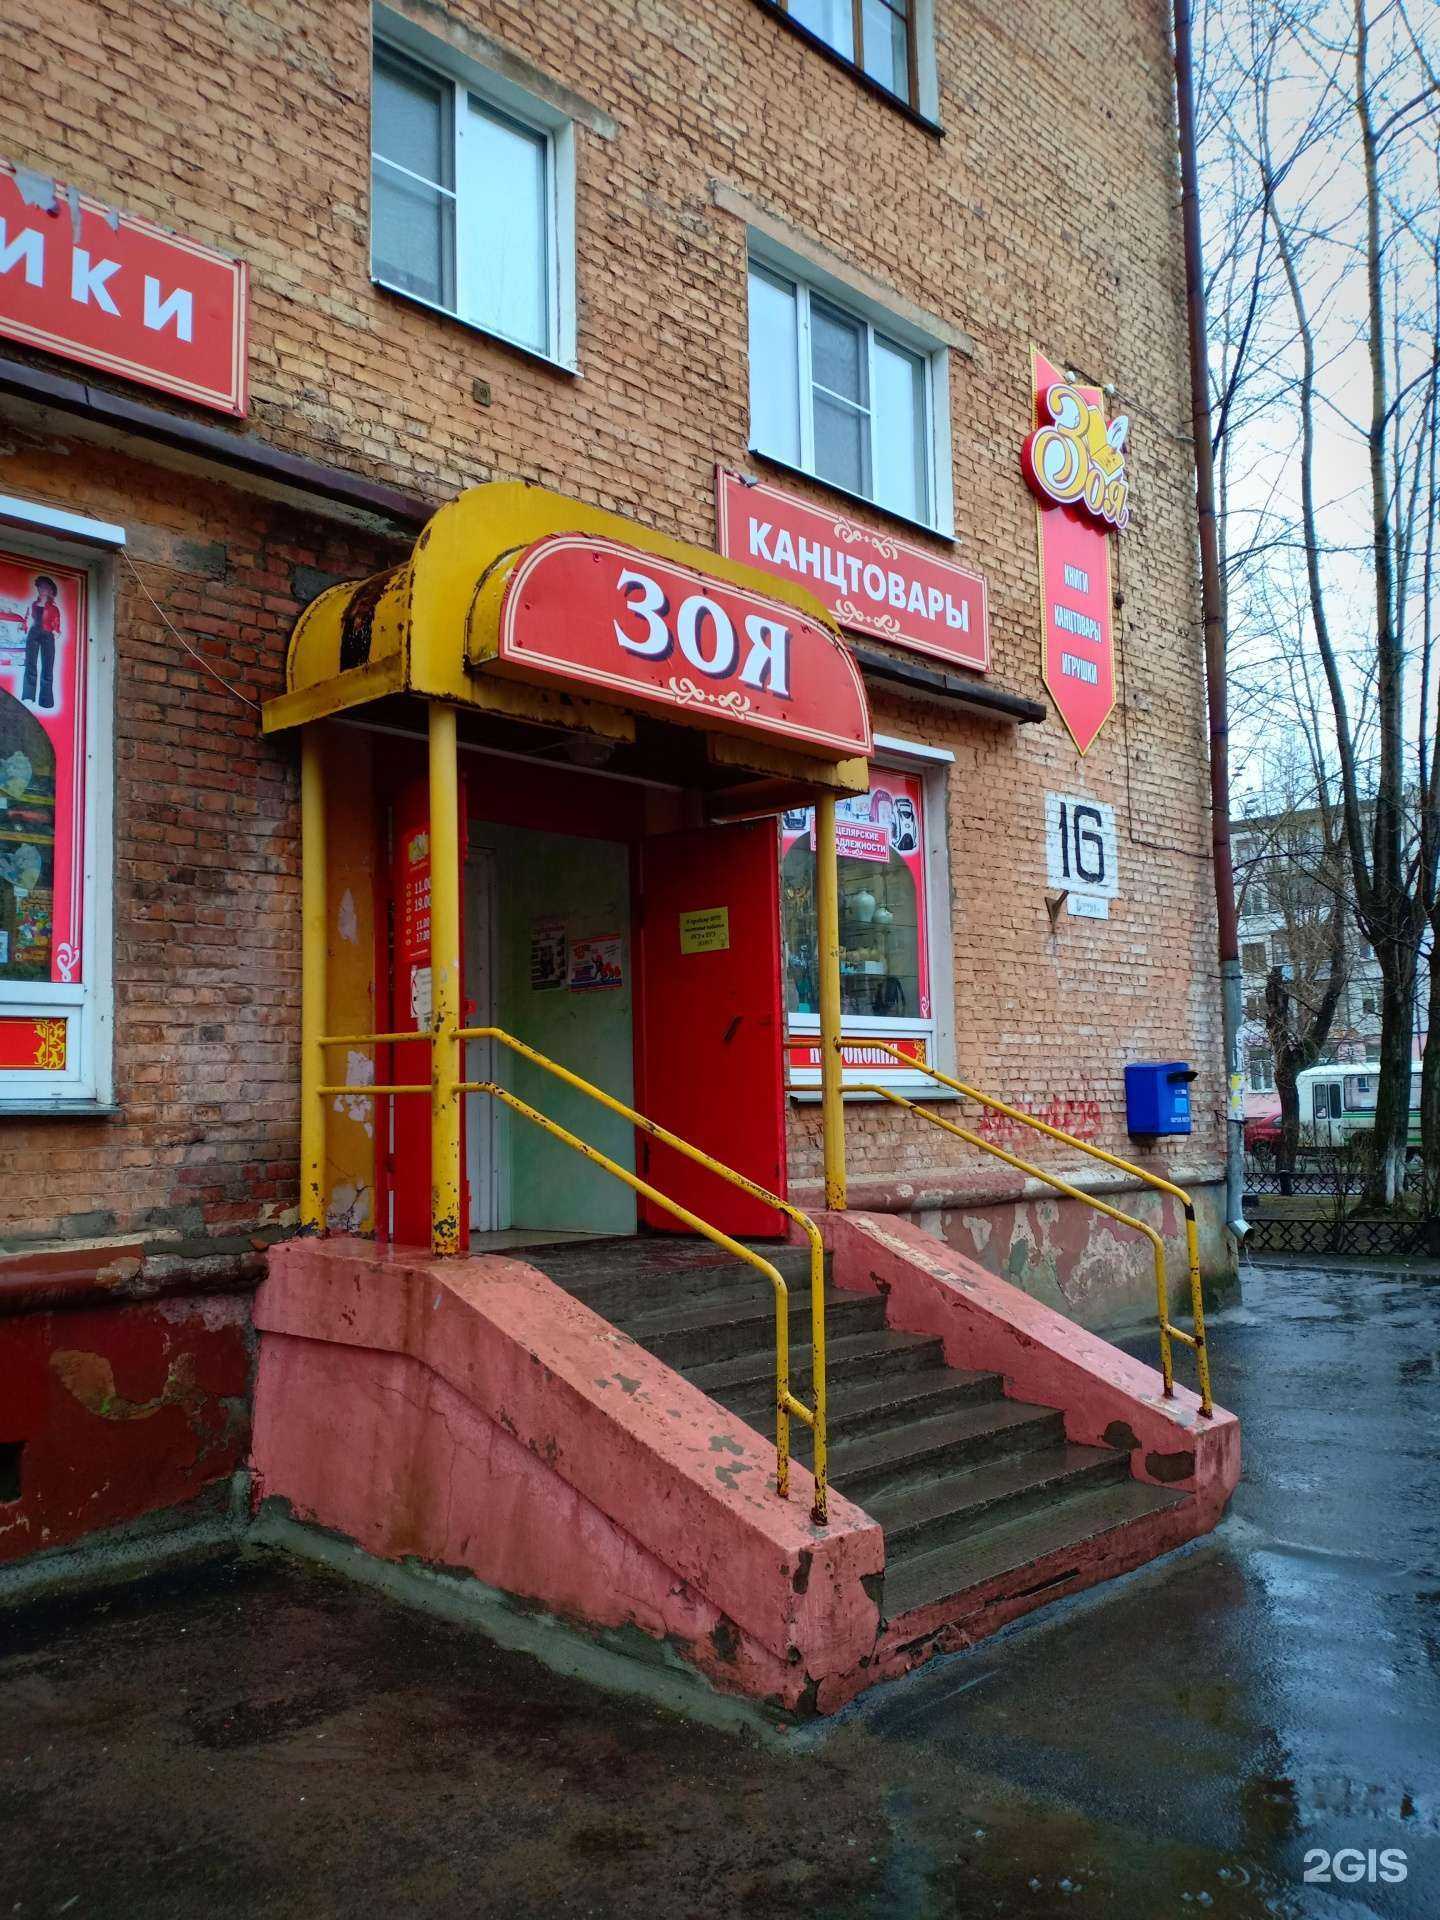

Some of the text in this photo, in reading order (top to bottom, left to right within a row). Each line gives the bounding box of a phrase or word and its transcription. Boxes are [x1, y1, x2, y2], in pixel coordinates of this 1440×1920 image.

[0, 216, 193, 343] ИКИ
[748, 516, 970, 633] КАНЦТОВАРЫ
[1064, 562, 1089, 595] КНИГИ
[612, 567, 793, 700] ЗОЯ
[1054, 603, 1102, 644] КАНЦТОВАРЫ
[1062, 652, 1098, 686] ИГРУШКИ
[835, 826, 880, 841] ЦЕЛЯРСКИЕ
[1059, 801, 1105, 883] 16
